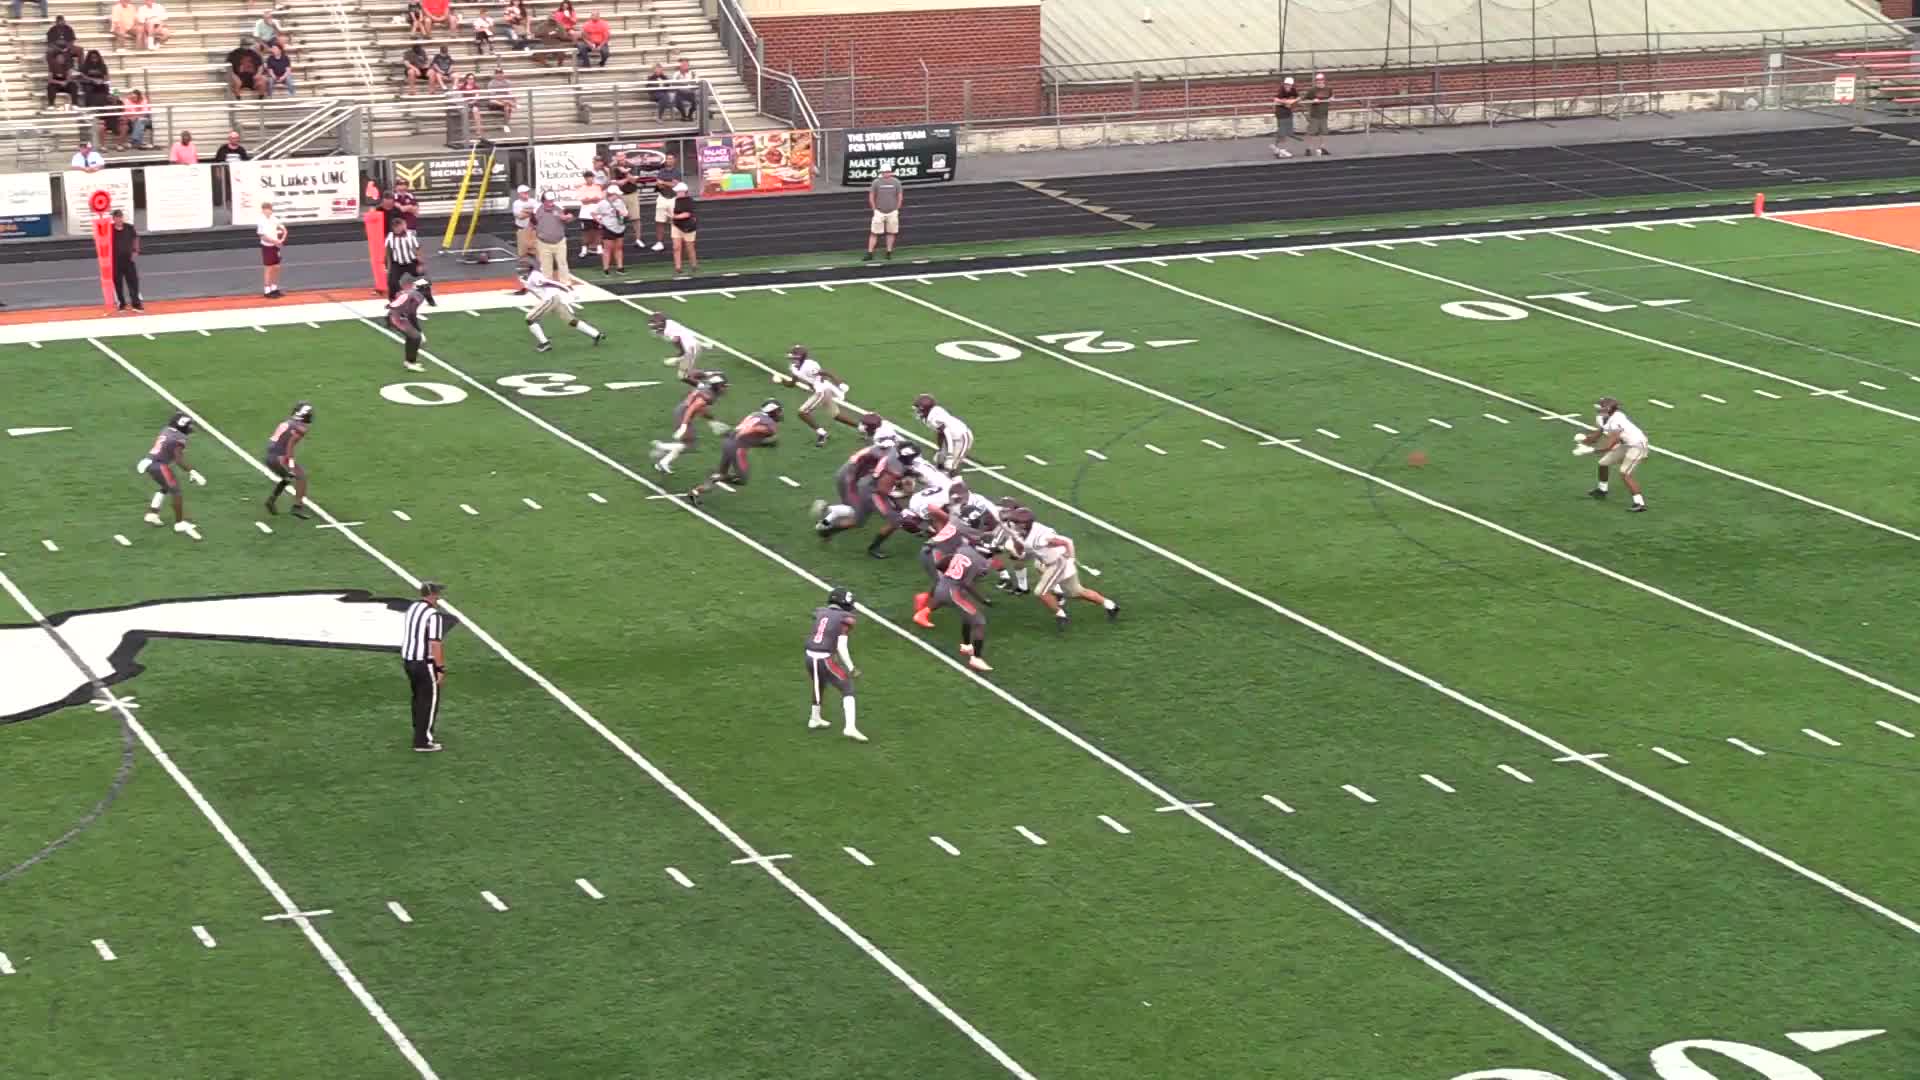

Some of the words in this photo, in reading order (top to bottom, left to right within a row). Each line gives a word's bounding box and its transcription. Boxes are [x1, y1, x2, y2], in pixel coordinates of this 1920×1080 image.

[847, 133, 864, 142] THE
[902, 130, 927, 139] TEAM
[848, 143, 866, 152] FOR
[866, 142, 883, 151] THE
[849, 158, 877, 168] MAKE
[877, 157, 896, 166] THE
[896, 155, 921, 166] CALL
[280, 173, 318, 187] Luke's
[322, 170, 348, 185] UMC
[813, 617, 829, 644] 1
